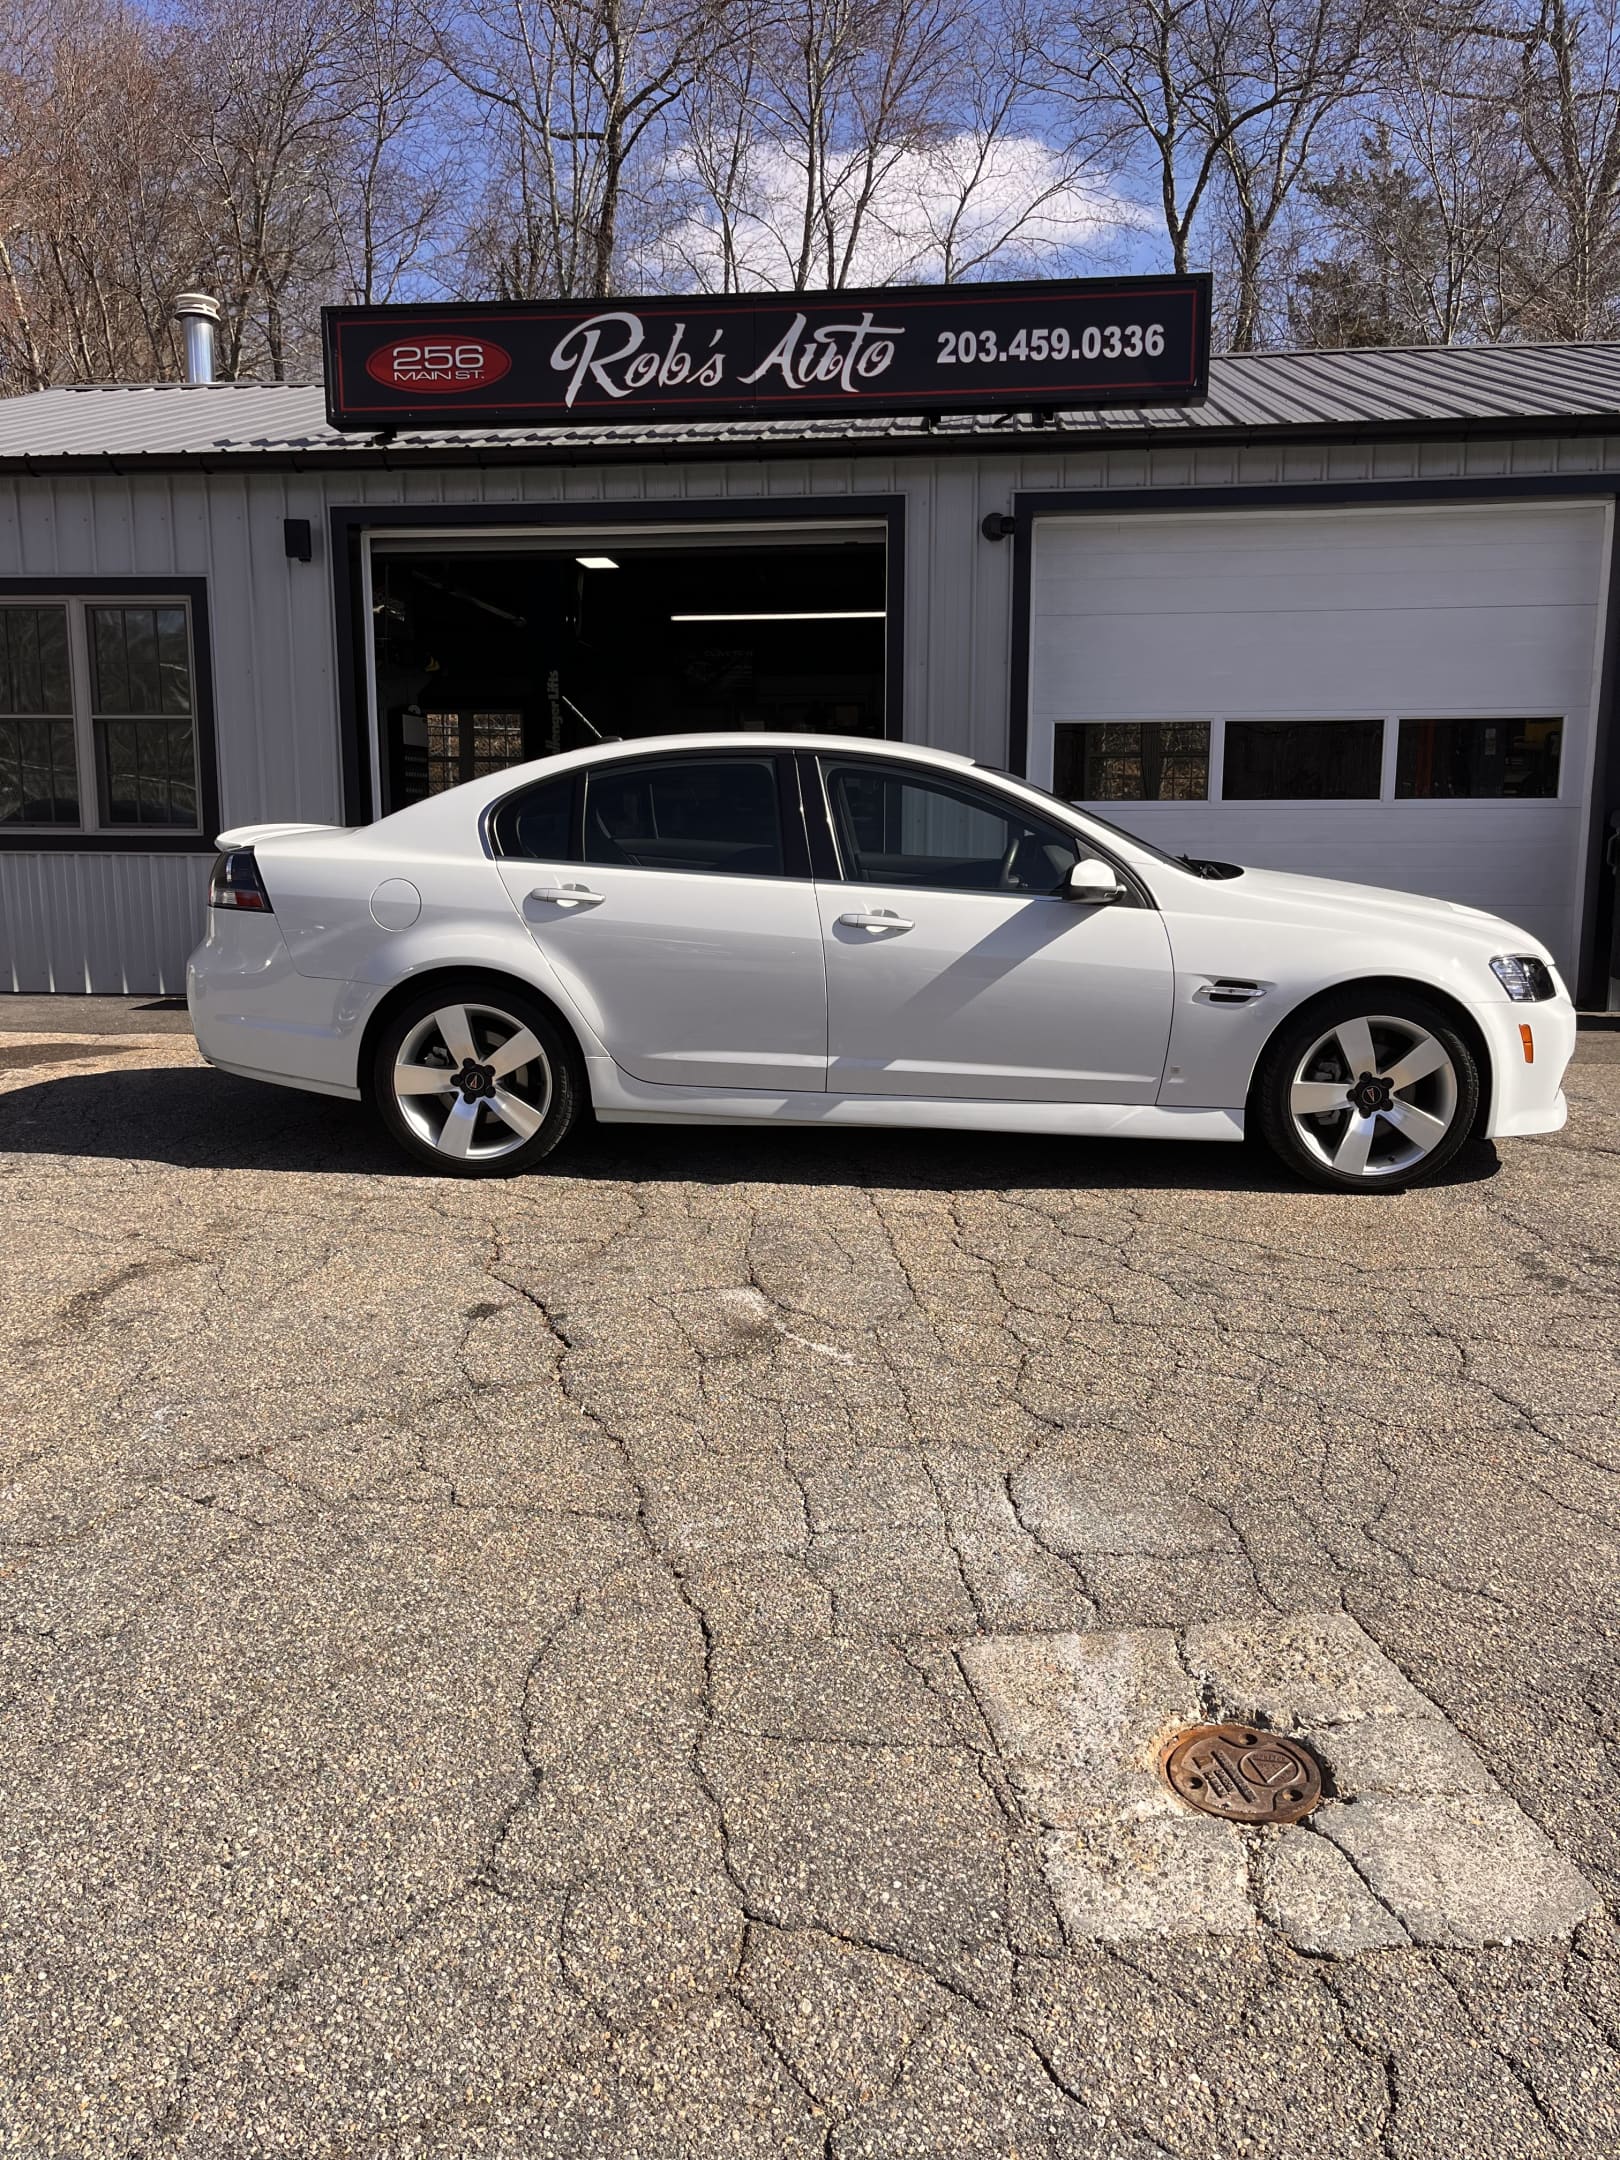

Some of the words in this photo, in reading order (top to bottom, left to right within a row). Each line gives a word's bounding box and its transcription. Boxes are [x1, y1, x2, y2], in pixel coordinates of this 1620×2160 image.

[393, 345, 484, 370] 256
[936, 325, 1165, 364] 203.459.0336
[550, 312, 726, 408] Rob's
[737, 312, 905, 392] Auto
[394, 371, 451, 381] MAIN
[456, 370, 485, 380] ST.
[546, 670, 560, 700] Lifts
